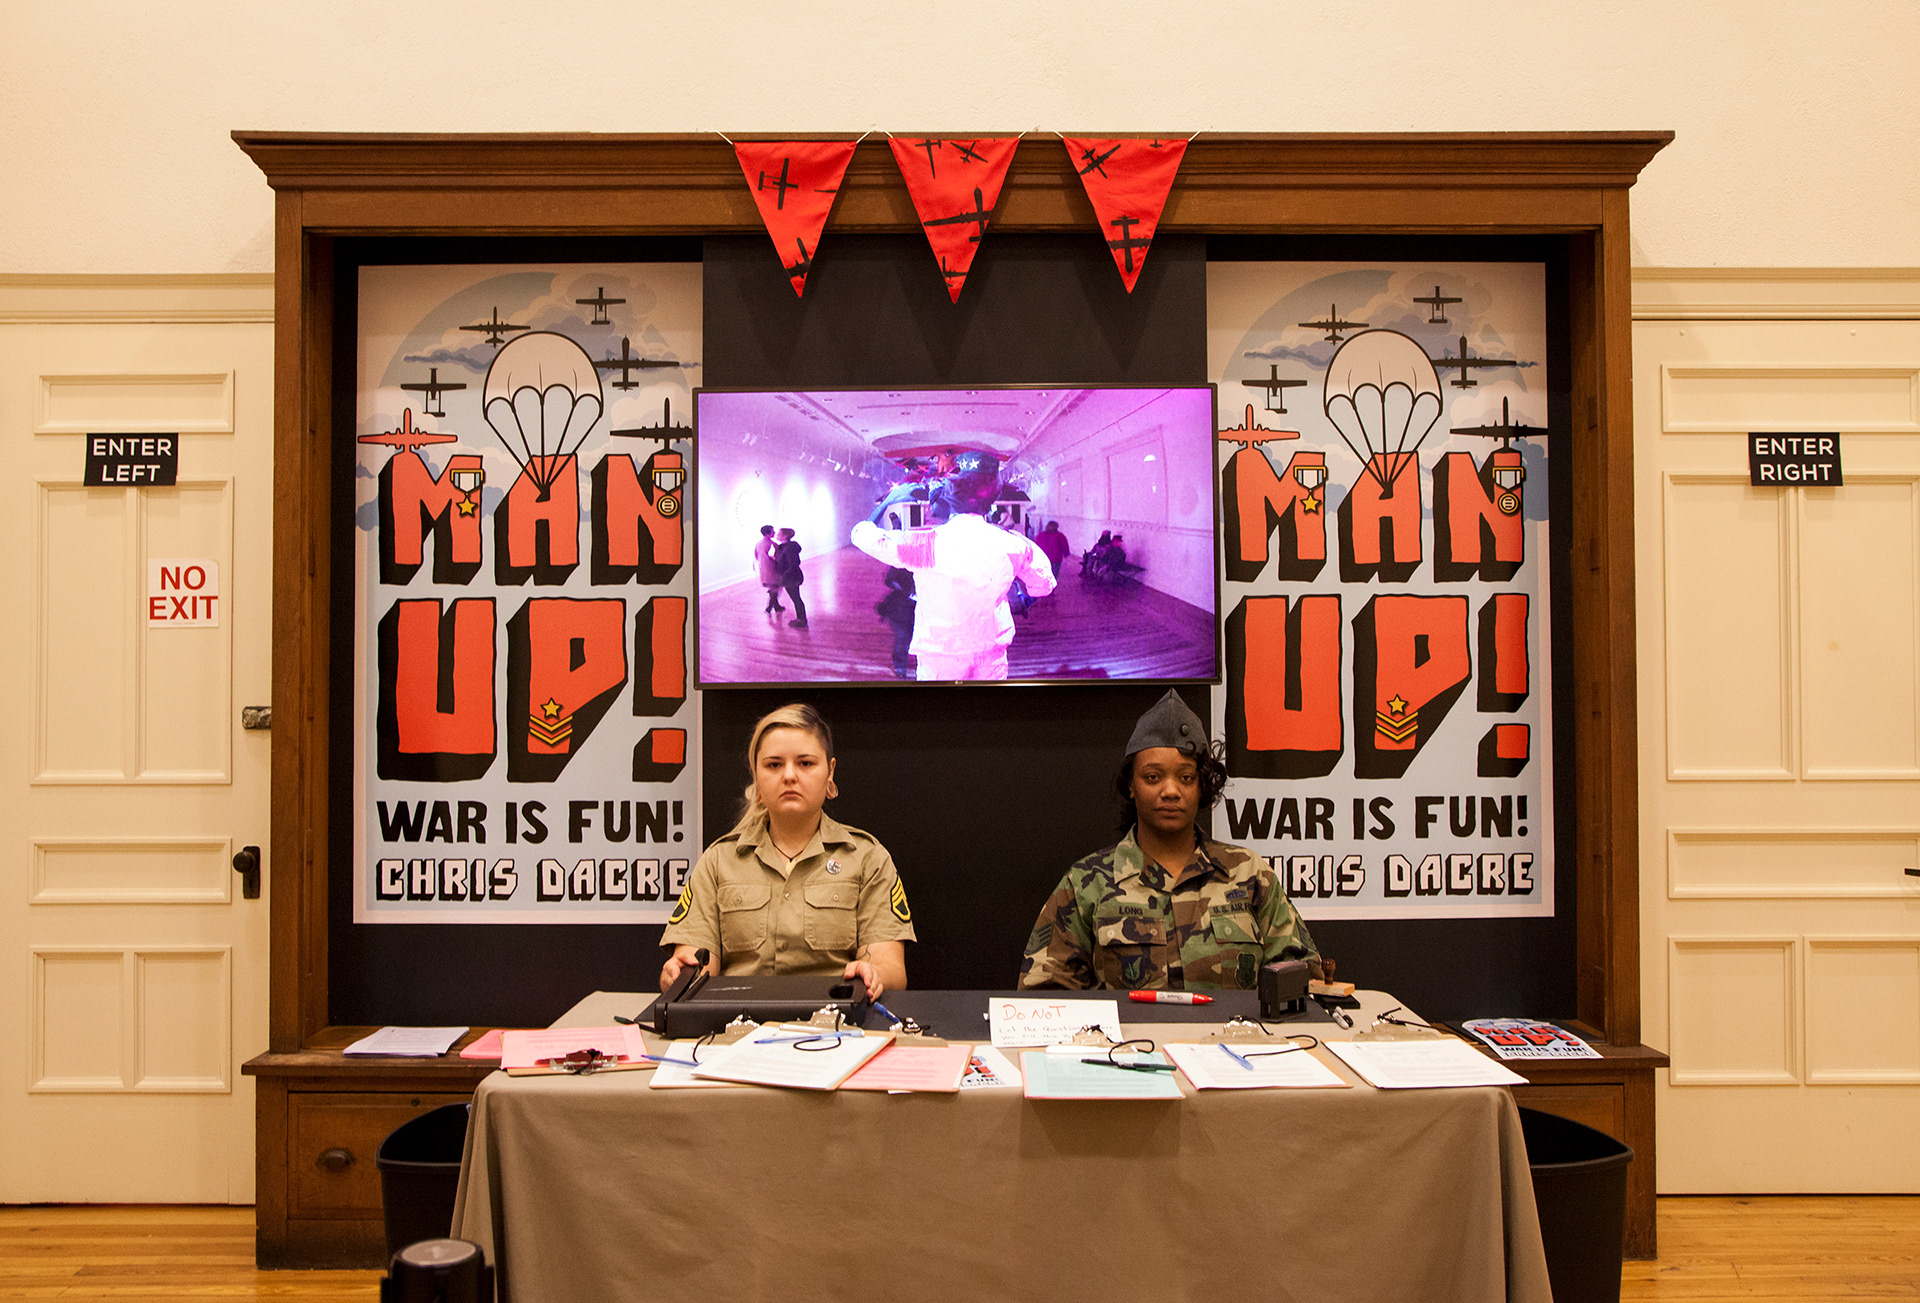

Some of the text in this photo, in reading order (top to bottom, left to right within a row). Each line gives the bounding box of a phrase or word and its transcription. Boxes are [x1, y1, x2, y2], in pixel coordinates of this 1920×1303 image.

[92, 438, 172, 456] ENTER
[1755, 438, 1834, 455] ENTER
[102, 465, 160, 482] LEFT
[1760, 463, 1832, 481] RIGHT
[378, 452, 684, 586] MAN
[1222, 450, 1524, 583] MAN
[160, 566, 206, 590] NO
[149, 595, 218, 621] EXIT
[377, 597, 688, 783] UP!
[1224, 593, 1530, 779] UP!
[376, 800, 684, 844] WAR IS FUN!
[1225, 795, 1529, 840] WAR IS FUN!
[376, 858, 689, 902] CHRIS DACRE
[1384, 853, 1534, 898] DACRE
[1118, 906, 1143, 915] LONG
[1230, 903, 1244, 912] AIR
[1486, 1034, 1580, 1046] UP!
